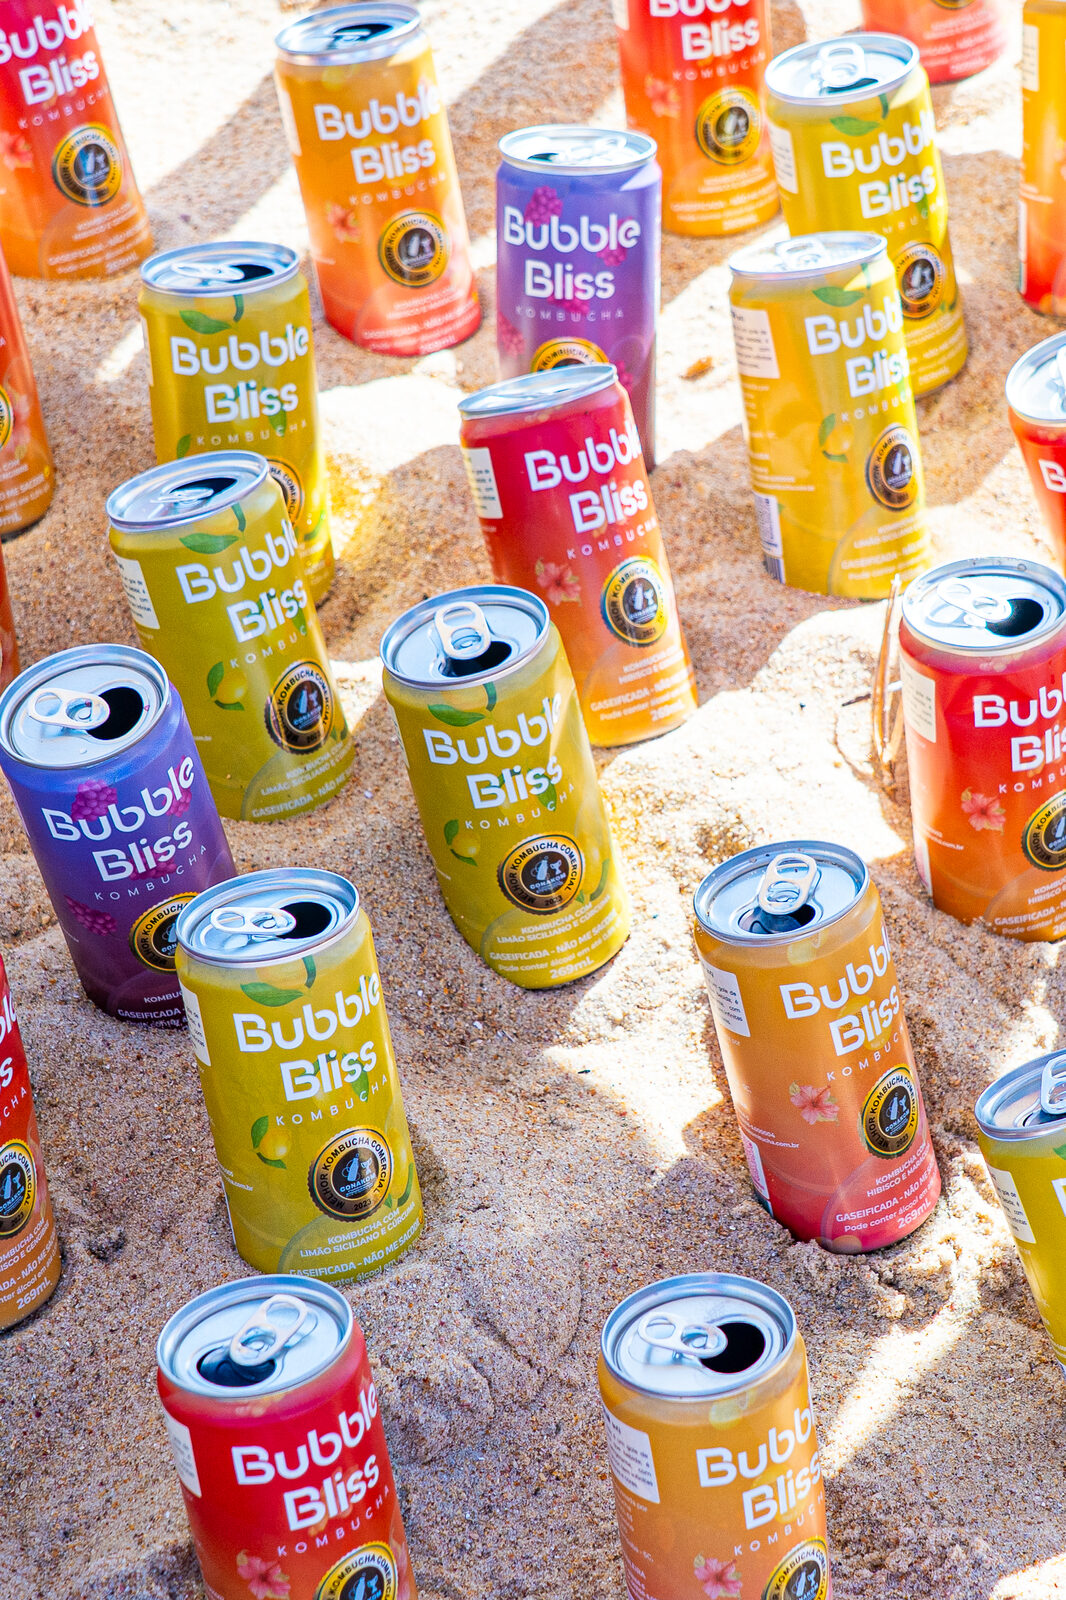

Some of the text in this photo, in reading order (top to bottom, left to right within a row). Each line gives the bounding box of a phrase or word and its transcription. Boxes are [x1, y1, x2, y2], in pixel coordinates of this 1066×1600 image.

[681, 18, 760, 61] Bliss
[18, 51, 100, 106] Bliss
[350, 139, 436, 184] Bliss
[858, 166, 936, 219] Bliss
[503, 205, 642, 253] Bubble
[525, 259, 616, 300] Bliss
[516, 304, 625, 322] KOMBUCHA
[170, 323, 310, 376] Bubble
[204, 380, 299, 424] Bliss
[197, 419, 307, 446] KOMBUCHA
[568, 480, 648, 534] Bliss
[226, 579, 308, 644] Bliss
[973, 671, 1066, 728] Bub
[41, 756, 195, 841] Bubble
[466, 756, 563, 809] Bliss
[252, 794, 315, 818] GASEIFICADA
[465, 783, 575, 830] KOMBUCHA
[92, 821, 193, 882] Bliss
[94, 845, 207, 901] KOMBUCHA
[511, 842, 559, 872] KOMBUCHA
[560, 843, 578, 892] COMERCIAL
[521, 901, 593, 934] KOMBUCHA COM
[526, 922, 572, 943] SICILIANO
[994, 906, 1056, 926] GASEIFICADA
[489, 948, 550, 961] GASEIFICADA
[556, 939, 578, 955] NÃO
[578, 930, 593, 946] ME
[549, 955, 595, 980] 269mL
[117, 1008, 181, 1019] GASEIFICADA
[232, 972, 380, 1053] Bubble
[829, 985, 899, 1056] Bliss
[280, 1040, 377, 1102] Bliss
[276, 1074, 388, 1127] KOMBUCHA
[869, 1075, 904, 1115] KOMBUCHA
[321, 1137, 370, 1172] KOMBUCHA
[370, 1139, 388, 1194] COMERCIAL
[875, 1154, 917, 1186] KOMBUCHA
[17, 1153, 33, 1206] COMERCIAL
[319, 1173, 345, 1210] MELHOR
[866, 1178, 901, 1198] HIBISCO
[353, 1199, 373, 1212] 2023
[835, 1196, 899, 1223] GASEIFICADA
[903, 1184, 920, 1199] NÃO
[844, 1221, 869, 1233] Pode
[869, 1211, 897, 1227] conter
[898, 1195, 918, 1215] álcool
[896, 1199, 931, 1229] 269mL
[0, 1231, 34, 1262] OMBUCHA
[299, 1246, 332, 1258] LIMÃO
[332, 1230, 380, 1253] SICILIANO
[327, 1207, 401, 1246] KOMBUCHA COM
[21, 1263, 38, 1280] NÃO
[362, 1250, 386, 1267] NÃO
[385, 1241, 400, 1256] ME
[231, 1382, 378, 1485] Bubble
[283, 1455, 379, 1531] Bliss
[742, 1451, 821, 1530] Bliss
[277, 1485, 390, 1557] KOMBUCHA
[329, 1554, 376, 1595] KOMBUCHA
